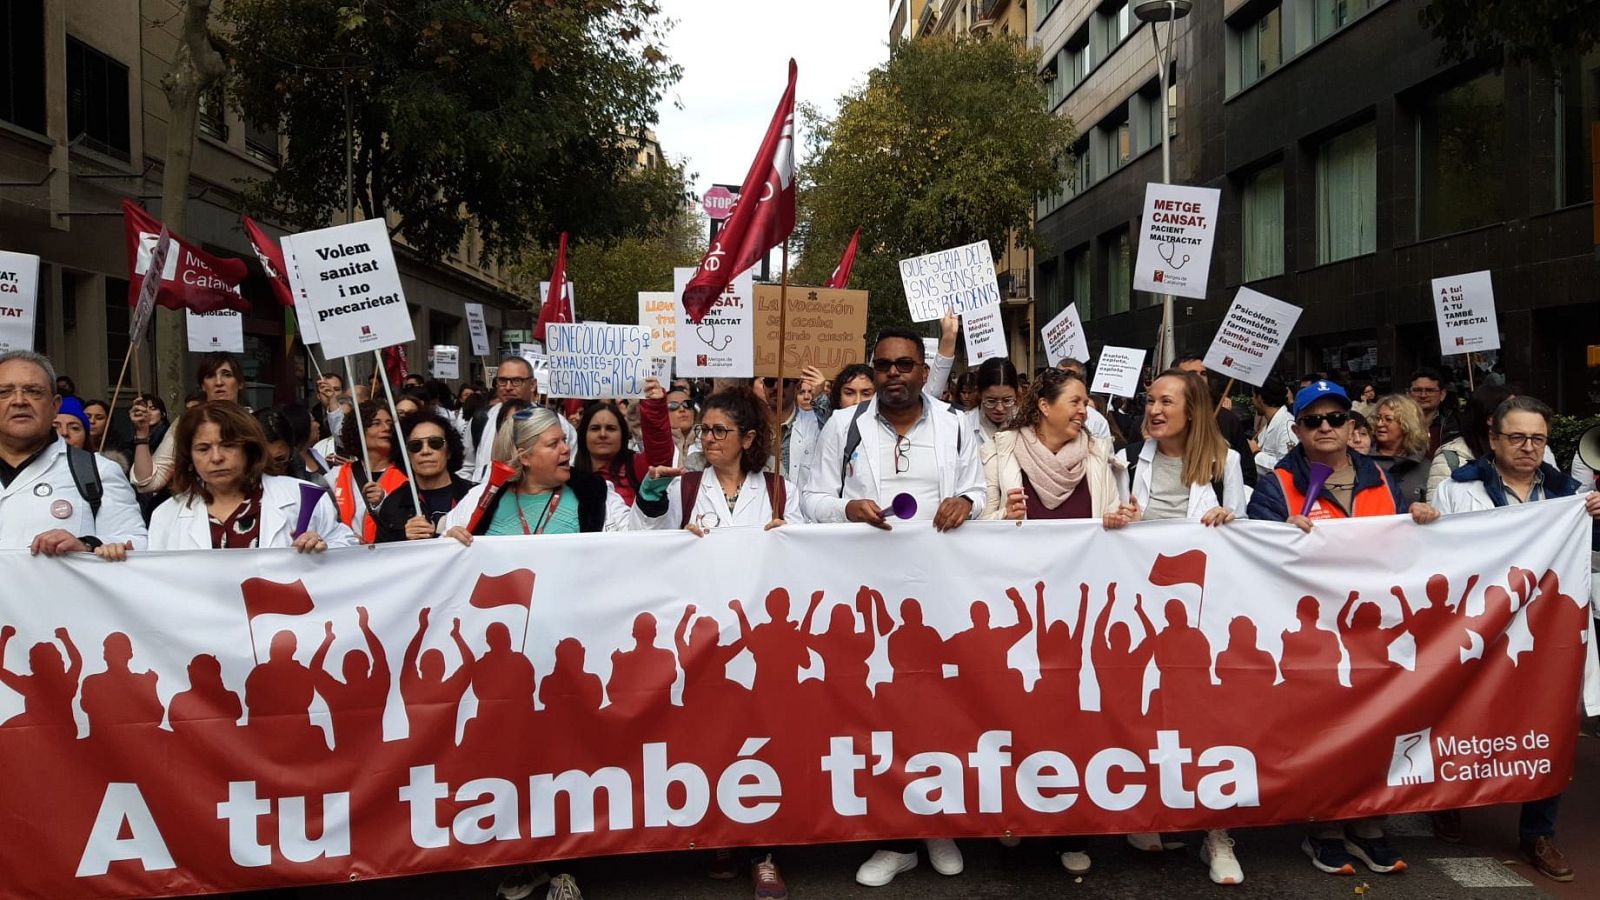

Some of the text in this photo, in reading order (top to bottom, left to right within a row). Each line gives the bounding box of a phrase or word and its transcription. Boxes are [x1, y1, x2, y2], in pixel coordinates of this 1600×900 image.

[704, 196, 732, 209] STOP
[1154, 200, 1201, 214] METGE
[1150, 225, 1184, 234] PACIENT
[1152, 212, 1207, 230] CANSAT,
[316, 242, 370, 260] Volem
[1150, 234, 1202, 246] MALTRACTAT
[320, 259, 379, 282] sanitat
[928, 250, 962, 274] SERIA
[966, 245, 984, 266] DEL
[338, 283, 370, 298] i no
[942, 282, 998, 316] RESIDENTS
[1450, 285, 1462, 294] tu!
[318, 292, 400, 322] precarietat
[1444, 310, 1474, 320] TAMBÉ
[1047, 316, 1069, 339] METGE
[1446, 316, 1488, 328] T'AFECTA!
[974, 336, 990, 344] futur
[1219, 336, 1264, 358] facultatius
[1223, 328, 1269, 350] també som
[784, 344, 857, 368] SALUD
[550, 370, 601, 396] GESTANTS
[602, 376, 610, 384] EN
[1436, 730, 1550, 758] Metges de
[1440, 758, 1552, 782] Catalunya
[75, 730, 1260, 878] A tu també t'afecta
